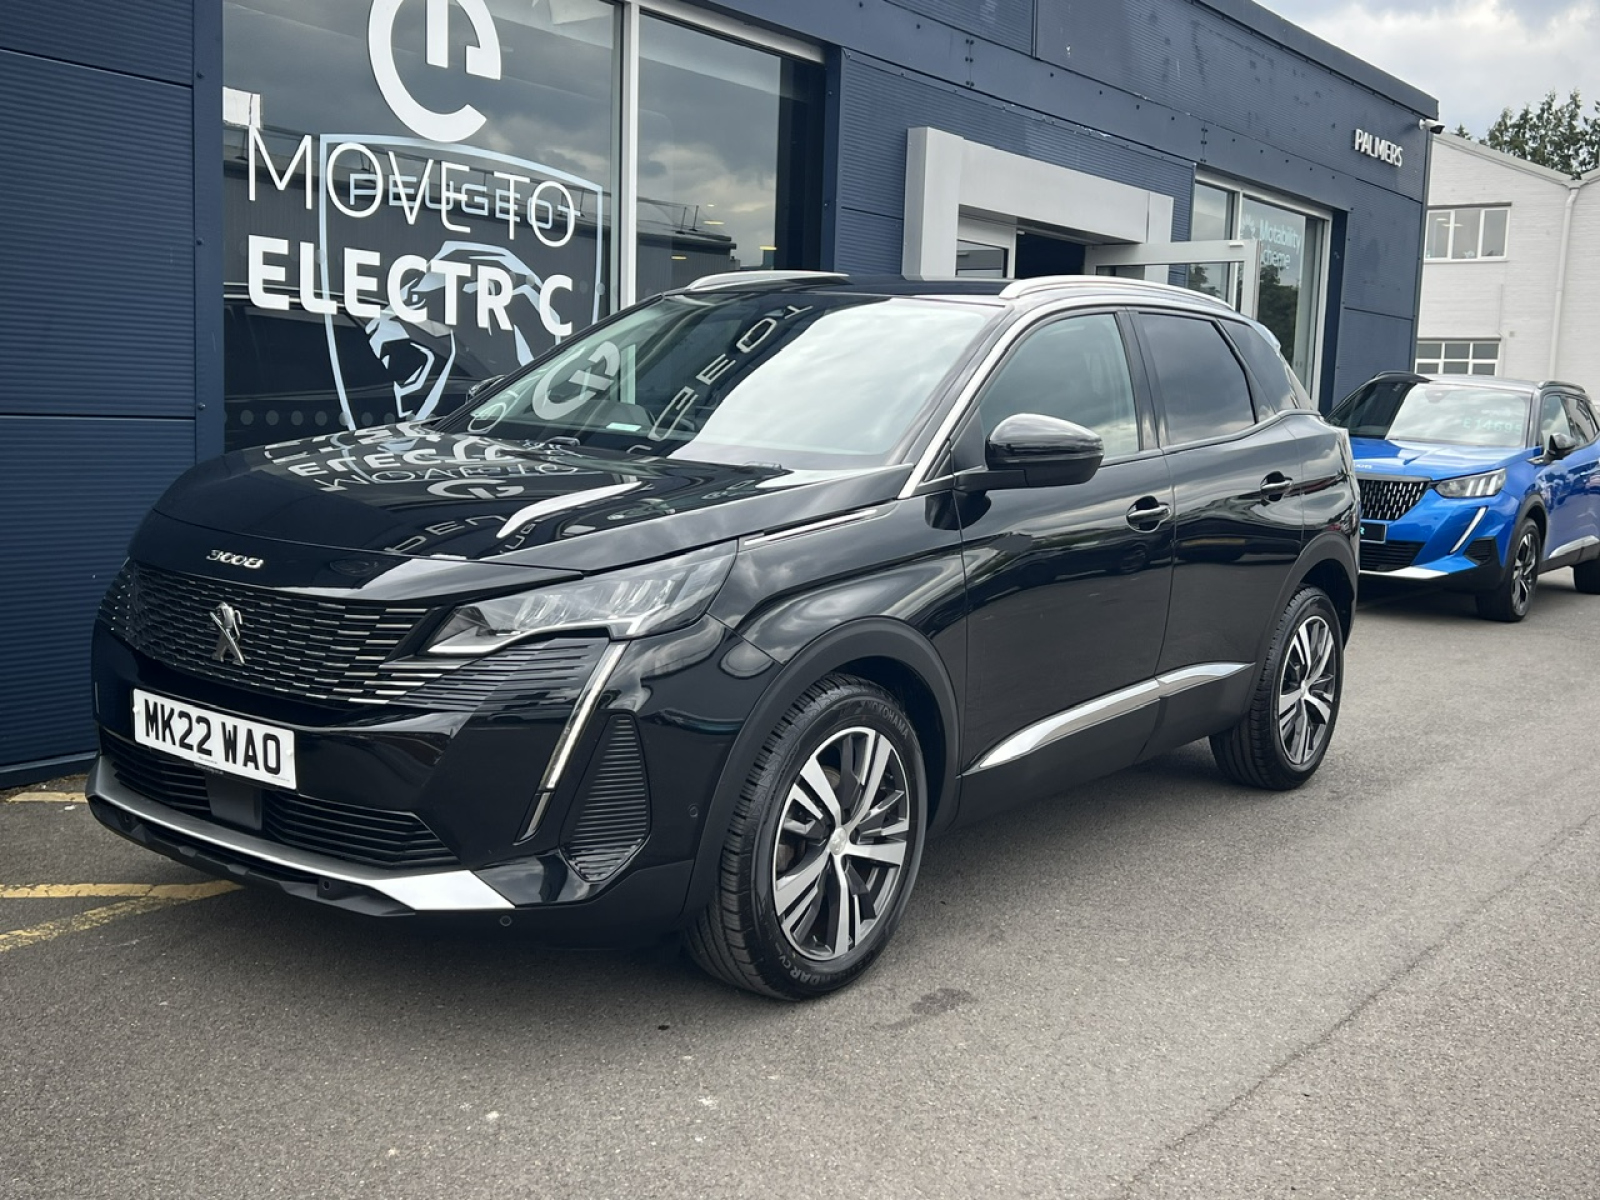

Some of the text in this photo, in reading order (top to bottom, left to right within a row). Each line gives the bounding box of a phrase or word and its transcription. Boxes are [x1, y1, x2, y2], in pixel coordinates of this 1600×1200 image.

[1355, 128, 1403, 168] PALMERS
[248, 126, 575, 247] MOVE TO
[350, 173, 581, 229] PEUGEOT
[1260, 219, 1301, 255] Motability
[206, 549, 264, 570] 3008
[144, 698, 281, 776] MK22 WAO
